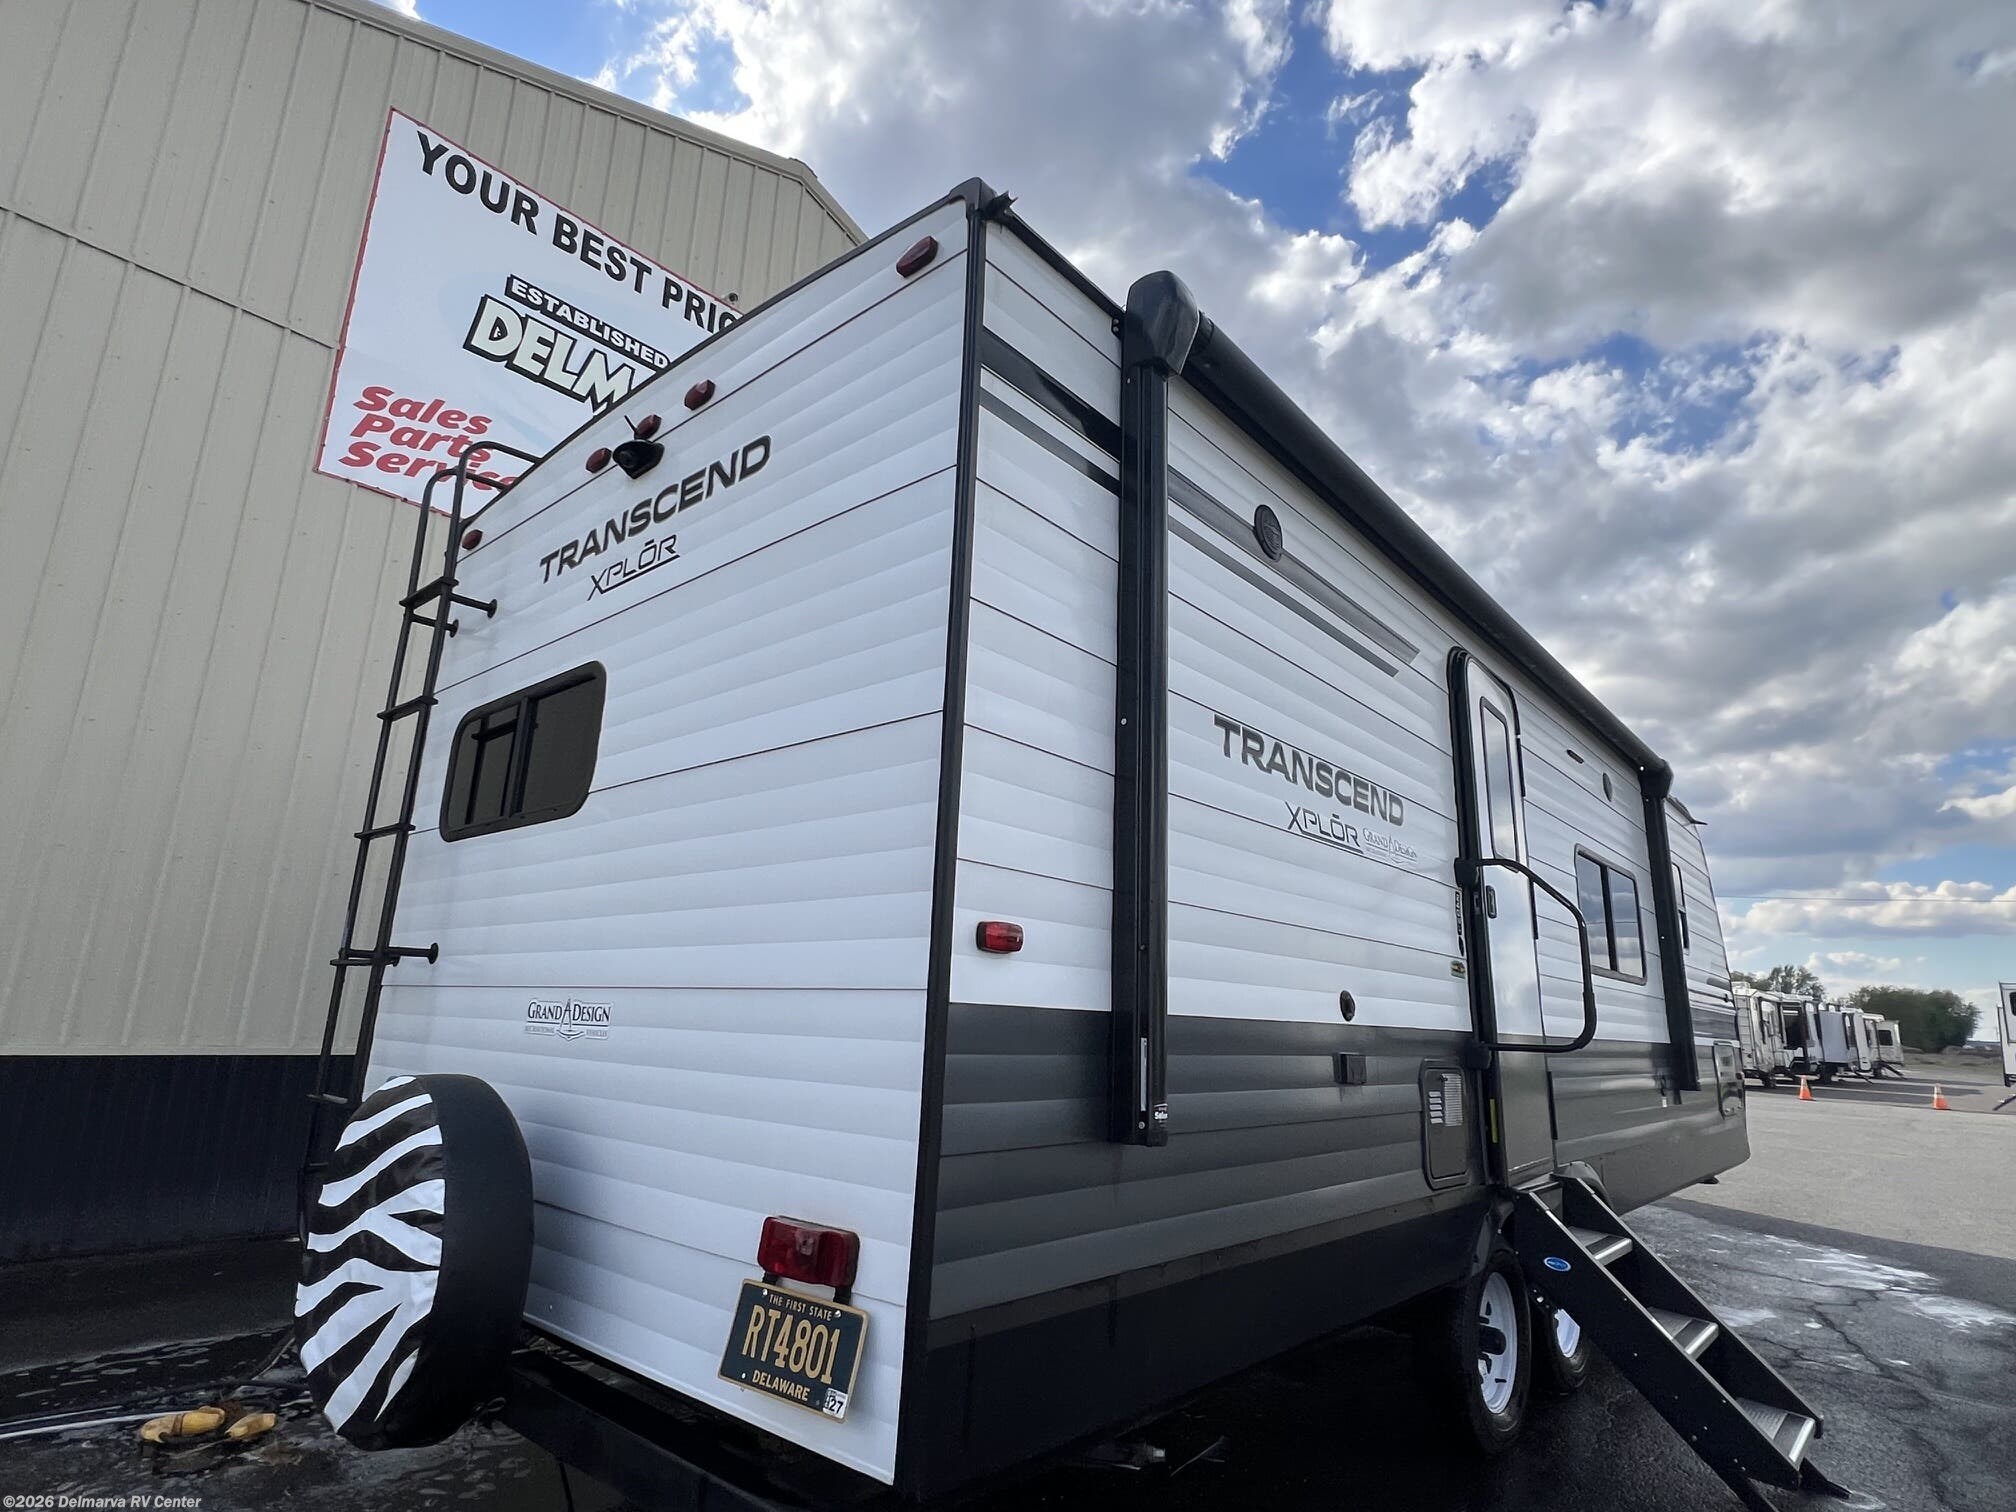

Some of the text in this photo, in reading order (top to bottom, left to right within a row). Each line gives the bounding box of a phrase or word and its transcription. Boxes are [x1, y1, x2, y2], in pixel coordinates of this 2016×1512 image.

[417, 130, 537, 236] YOUR
[553, 213, 652, 294] BEST
[511, 278, 669, 369] ESTABLISHED
[350, 413, 490, 462] Parts
[353, 386, 492, 434] Sales
[539, 435, 771, 584] TRANSCEND
[1214, 714, 1404, 826] TRANSCEND
[741, 1304, 841, 1385] RT4801
[769, 1293, 833, 1321] THE FIRST STATE
[752, 1369, 810, 1402] DELAWARE
